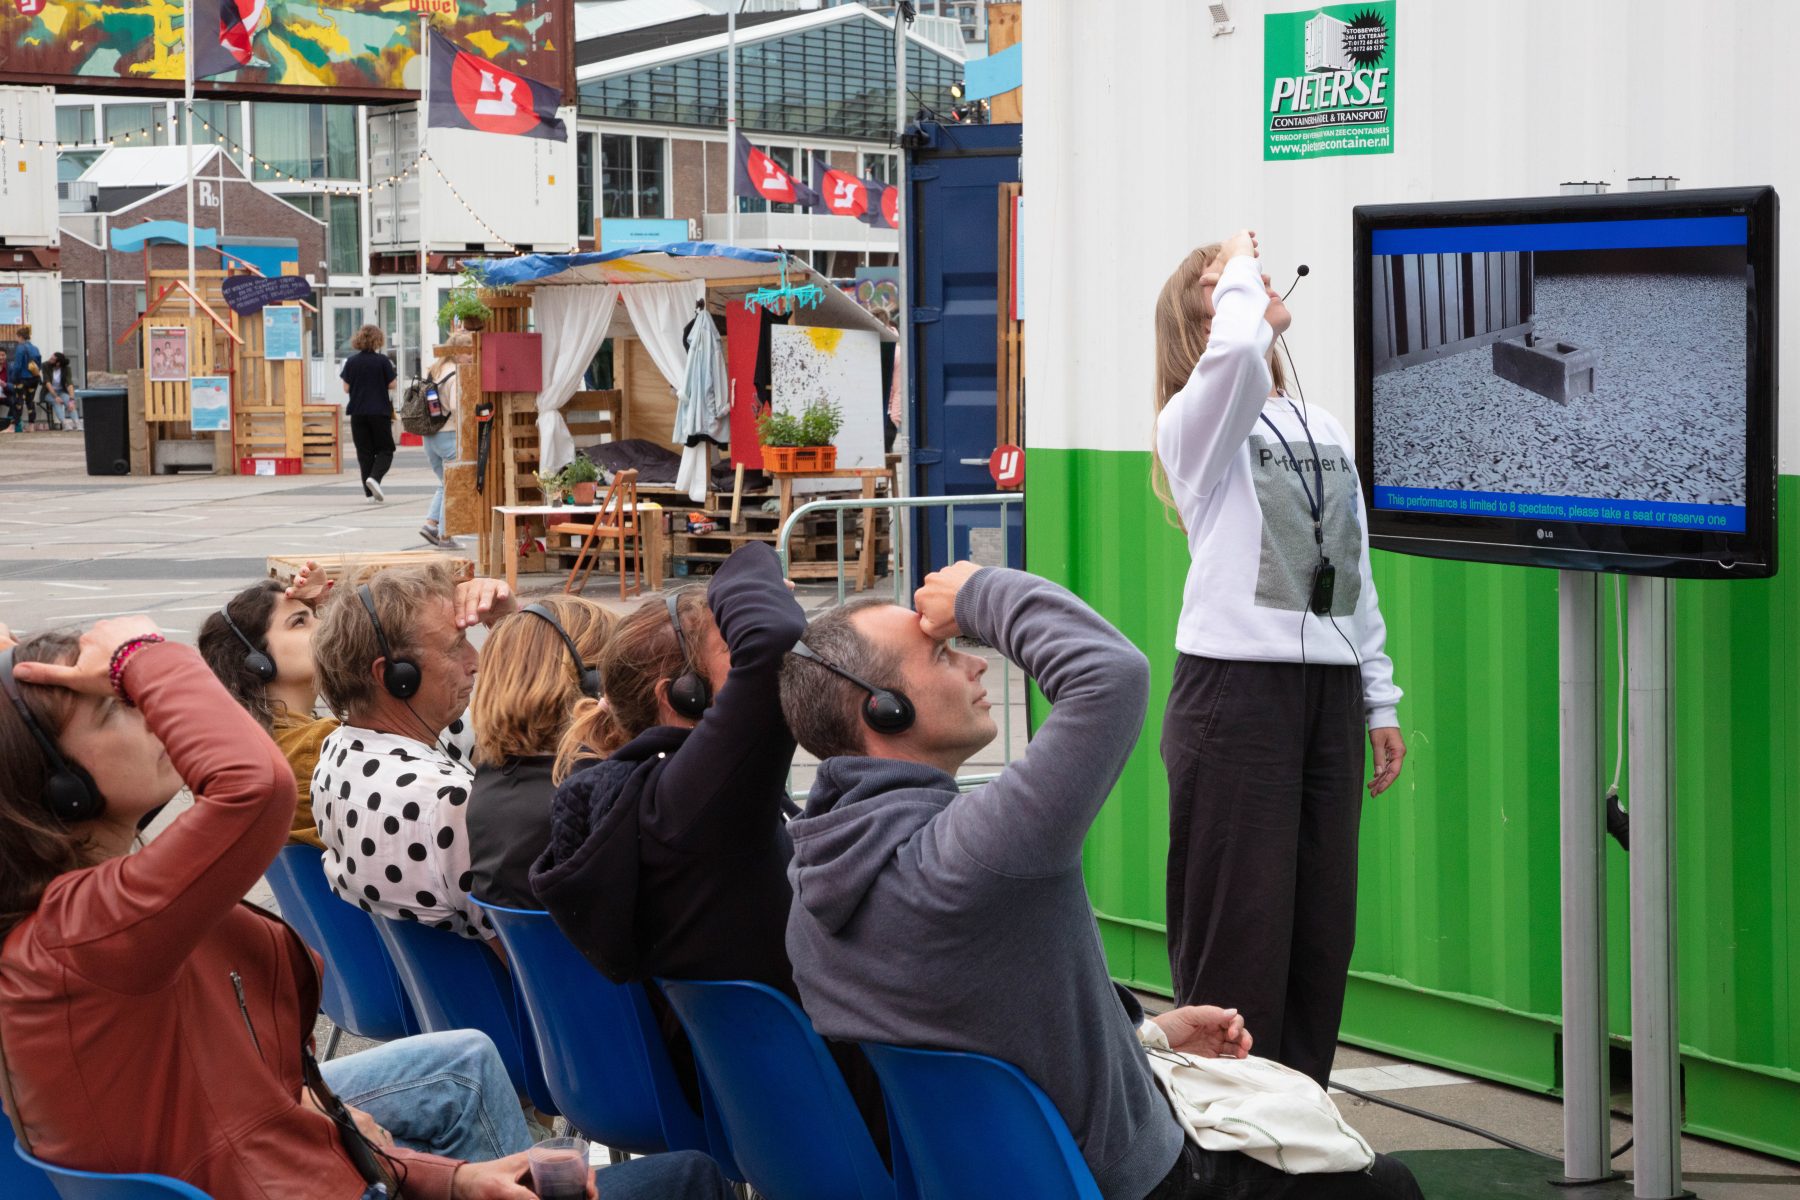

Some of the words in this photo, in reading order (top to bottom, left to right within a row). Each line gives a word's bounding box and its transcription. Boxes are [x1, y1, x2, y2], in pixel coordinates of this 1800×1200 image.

[1270, 67, 1389, 113] PIETERSE
[1330, 113, 1336, 122] &
[1337, 110, 1384, 121] TRANSPORT
[1335, 127, 1389, 136] ZEECONTAINERS
[199, 181, 220, 207] Rb
[1340, 457, 1352, 474] A
[1387, 493, 1404, 505] This
[1406, 495, 1458, 508] performance
[1460, 499, 1467, 509] is
[1469, 499, 1497, 511] limited
[1499, 500, 1508, 512] to
[1510, 501, 1516, 512] 8
[1518, 503, 1566, 517] spectators,
[1568, 505, 1599, 518] please
[1601, 507, 1621, 519] take
[1624, 510, 1630, 519] a
[1633, 510, 1653, 521] seat
[1655, 512, 1666, 521] or
[1668, 513, 1705, 524] reserve
[1707, 515, 1727, 526] one
[1545, 530, 1554, 538] LG
